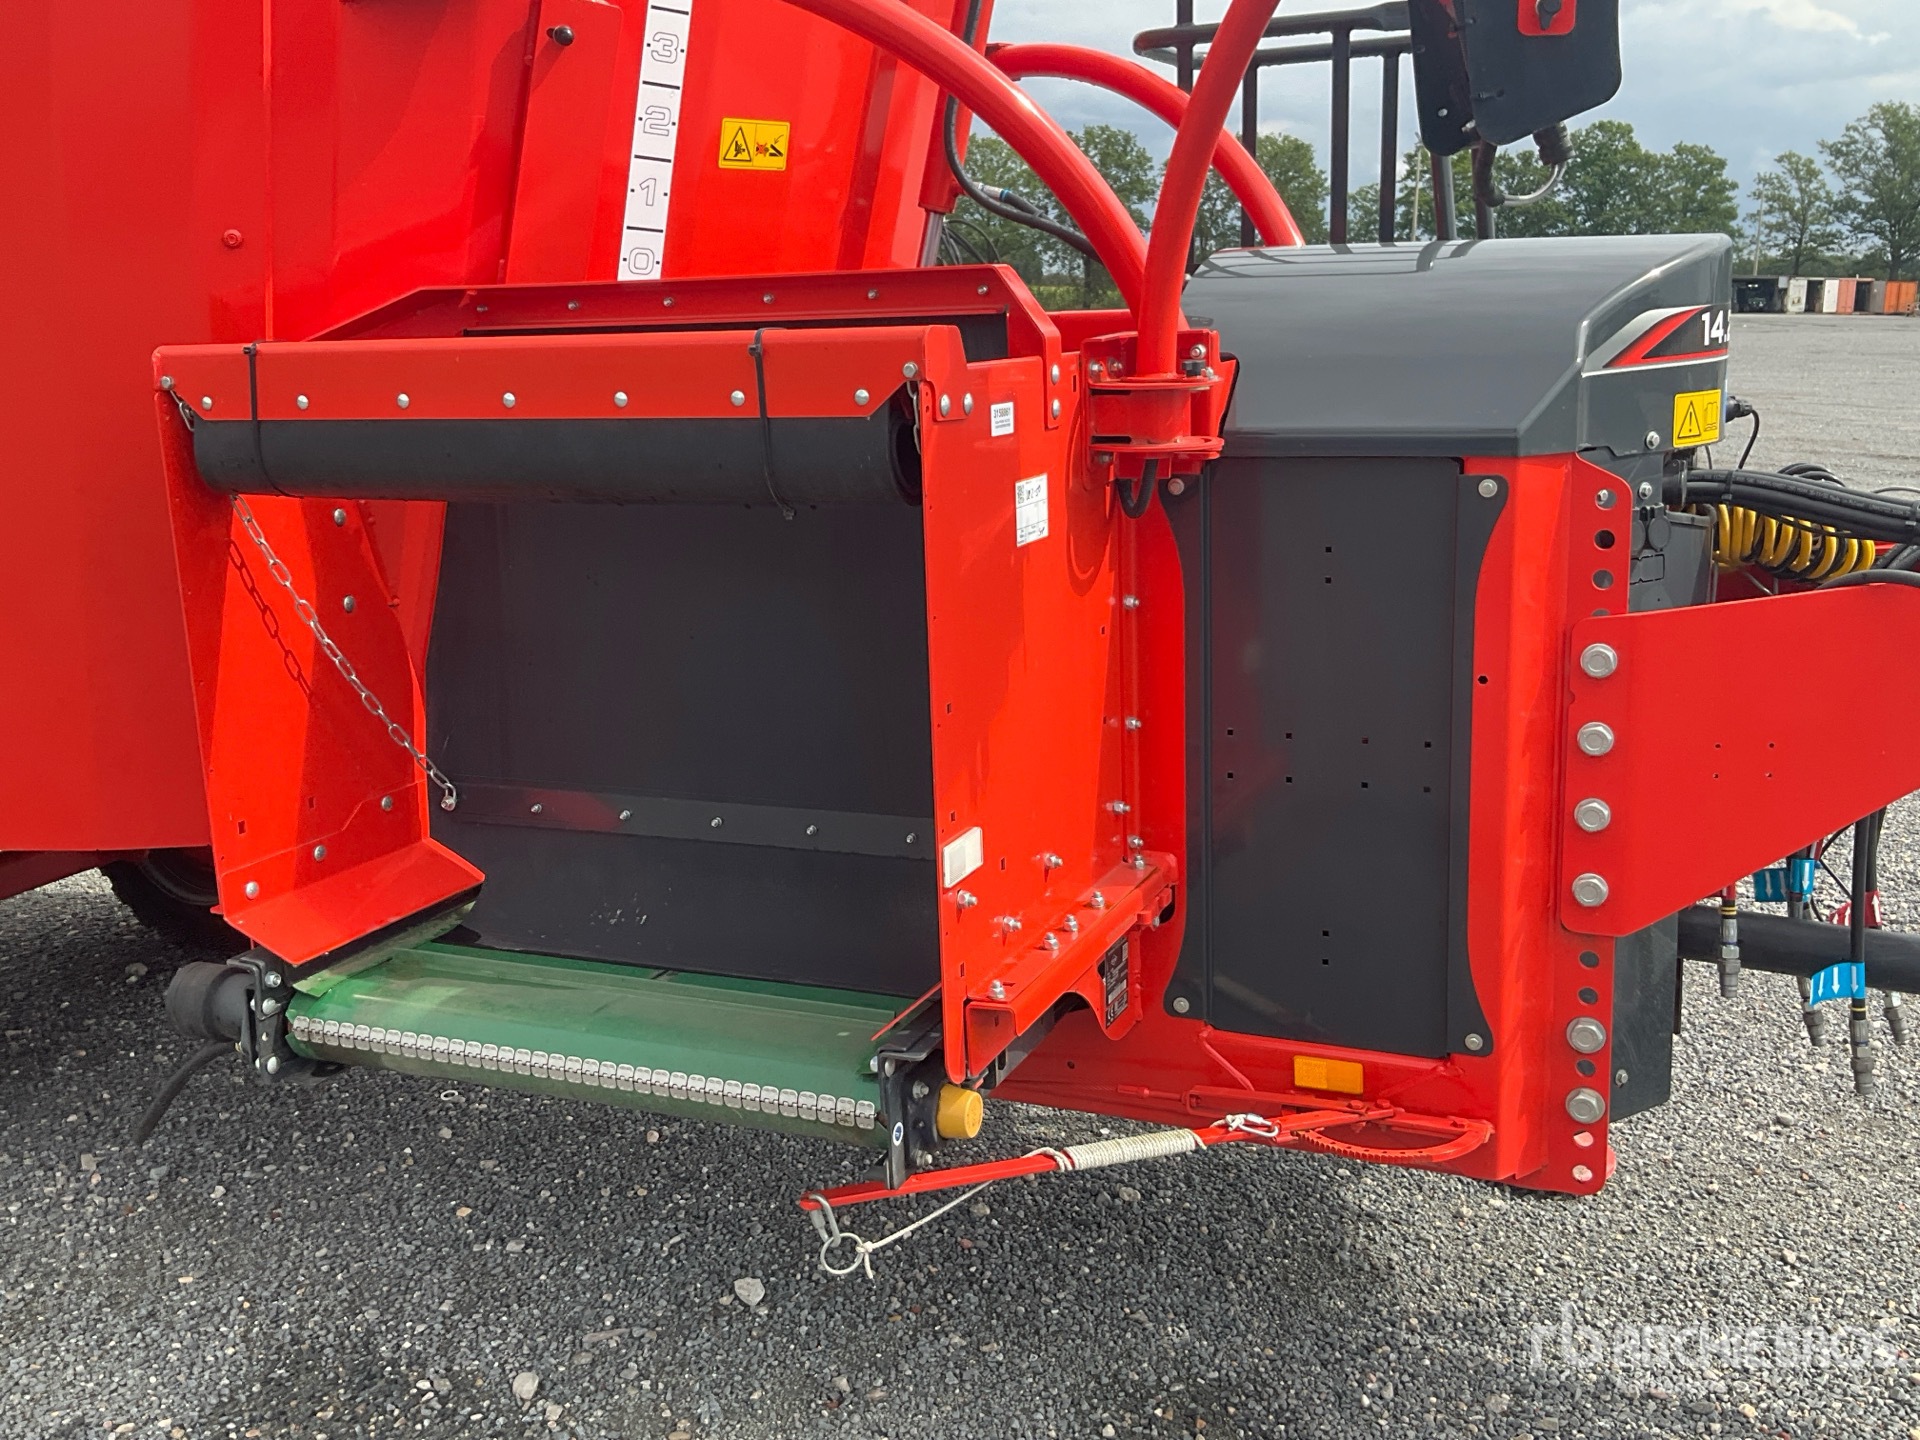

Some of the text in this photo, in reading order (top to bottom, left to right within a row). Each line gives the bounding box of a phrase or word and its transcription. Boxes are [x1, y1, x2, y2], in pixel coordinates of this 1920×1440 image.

[651, 31, 679, 64] 3
[643, 105, 671, 136] 2
[639, 177, 657, 207] 1
[628, 247, 655, 275] 0
